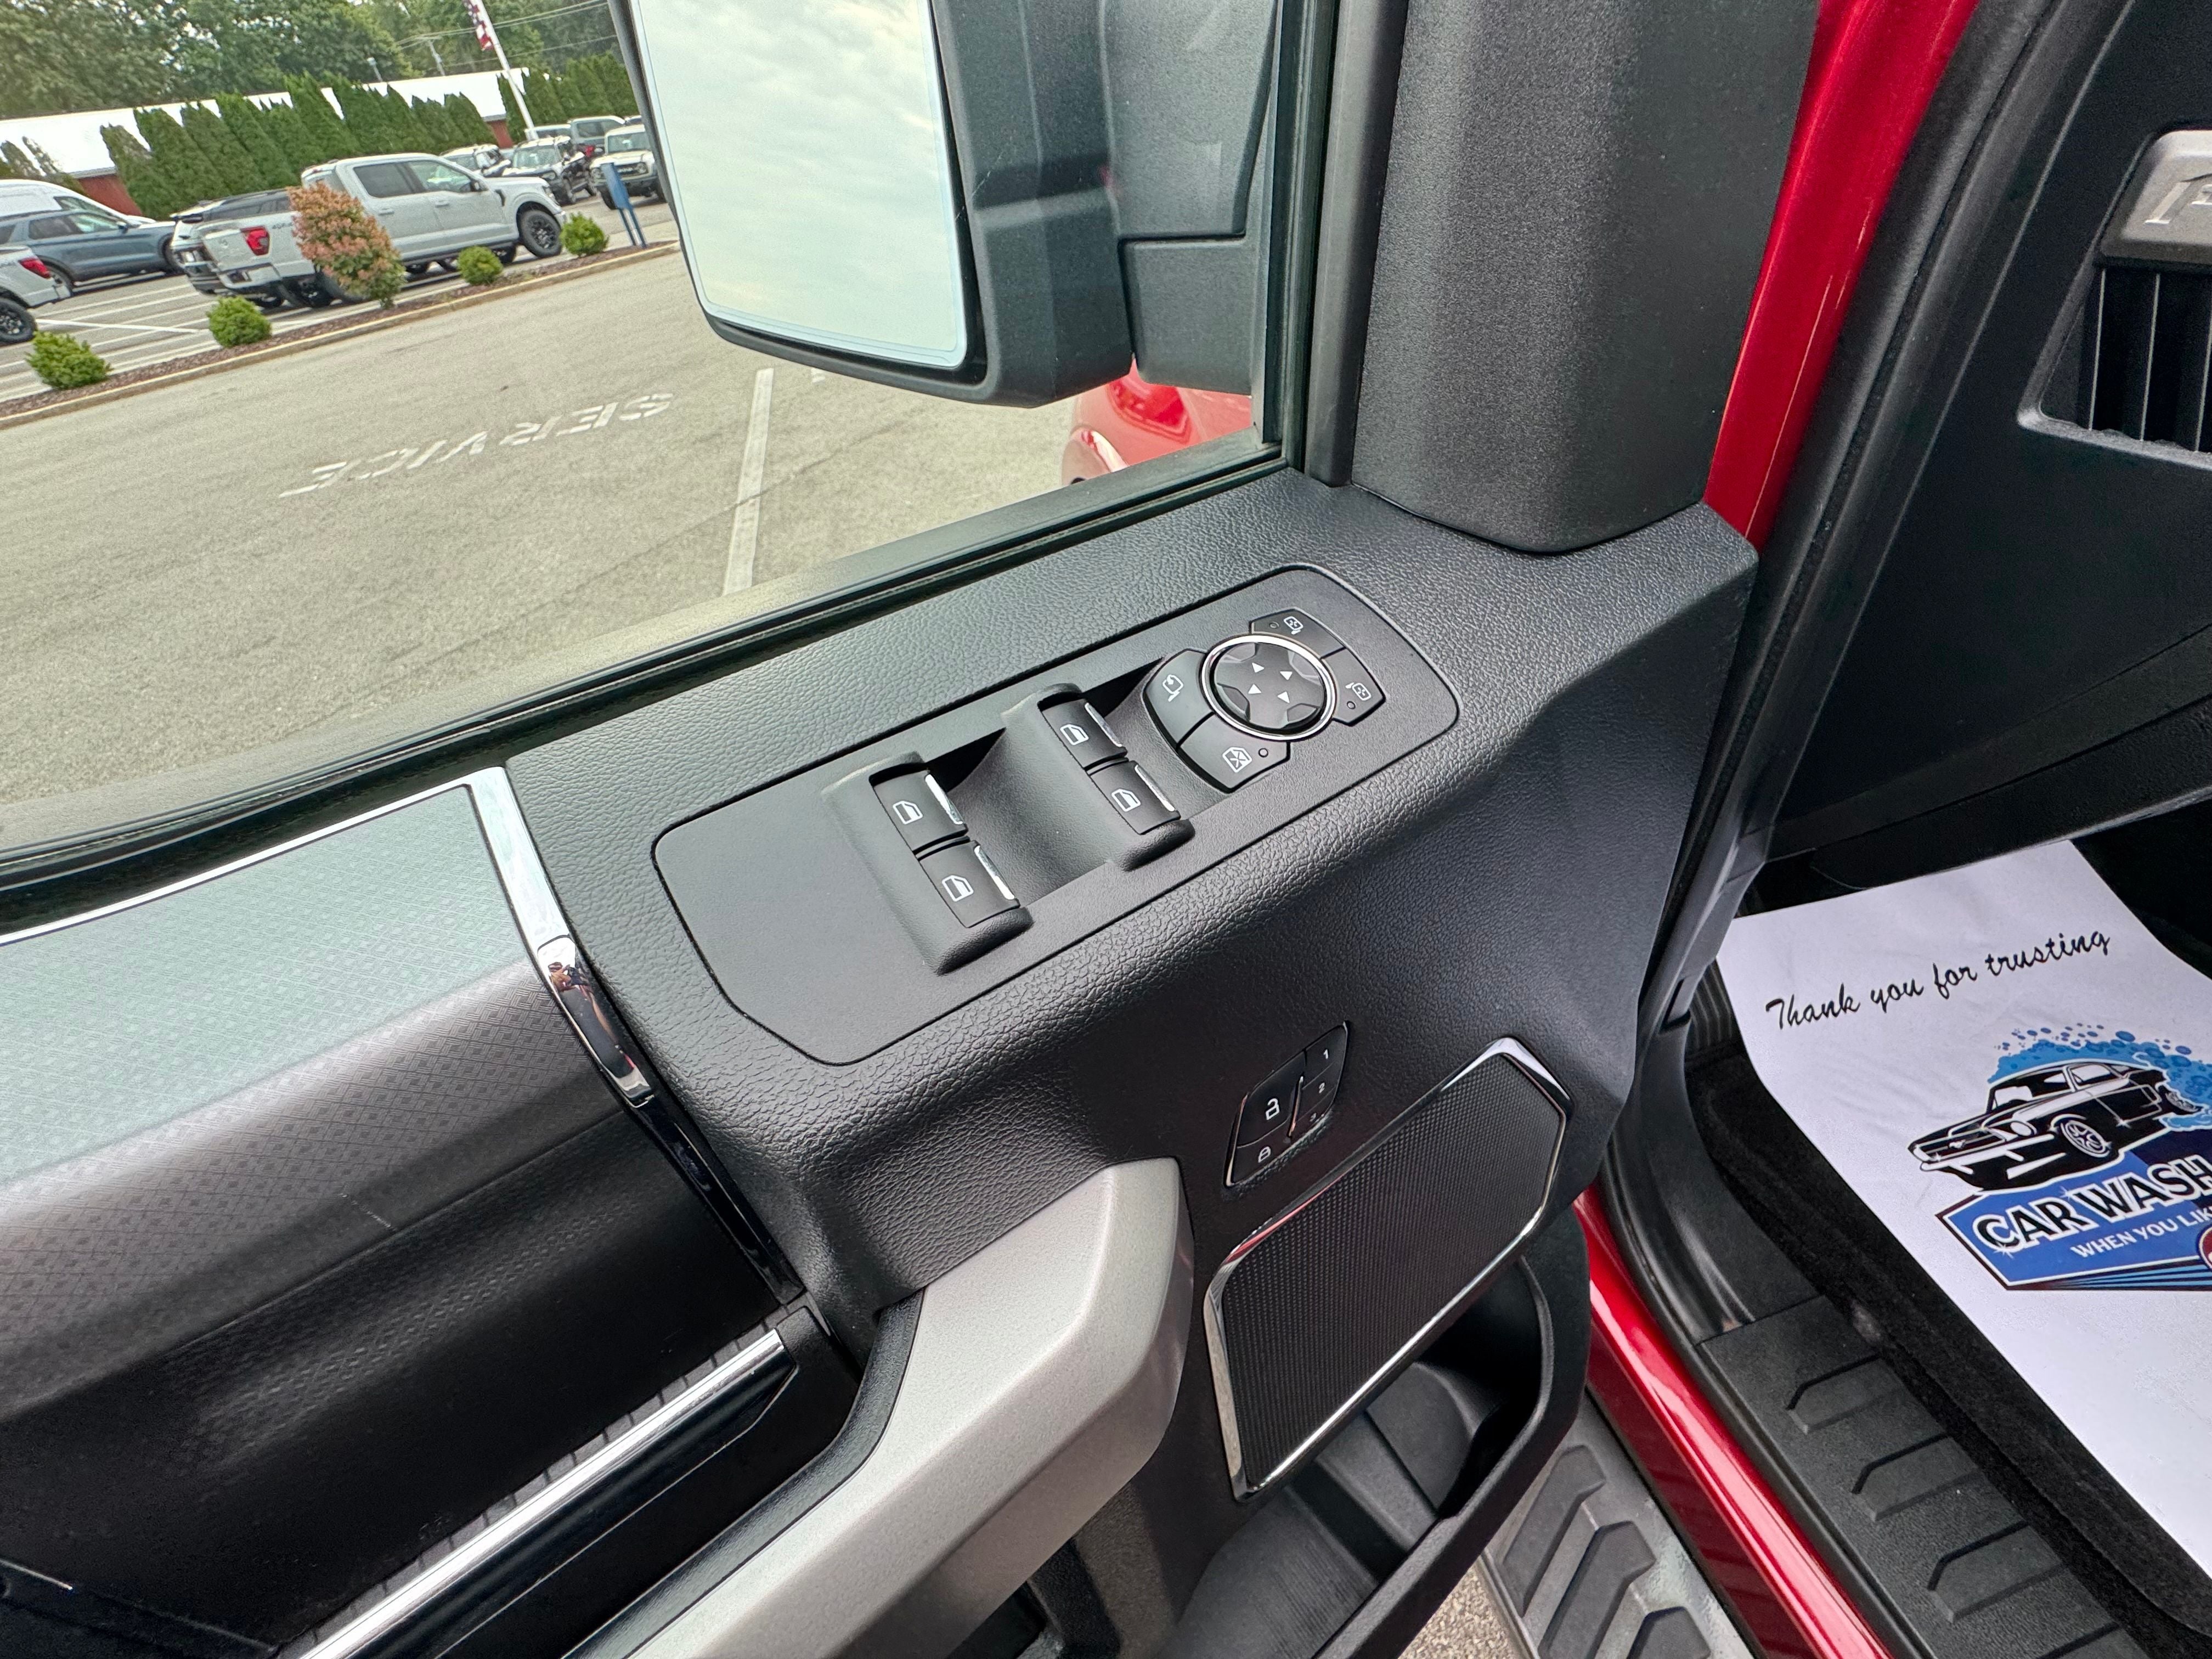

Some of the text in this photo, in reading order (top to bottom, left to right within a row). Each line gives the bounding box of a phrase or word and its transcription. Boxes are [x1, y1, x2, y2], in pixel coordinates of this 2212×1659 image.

[279, 393, 674, 498] SERVICE
[1766, 930, 2111, 1030] Thank you for trusting
[1319, 1082, 1325, 1094] 2
[1323, 1048, 1329, 1059] 1
[1973, 1154, 2212, 1253] CAR WASH
[2070, 1229, 2137, 1258] WHEN
[2132, 1218, 2179, 1240] YOU
